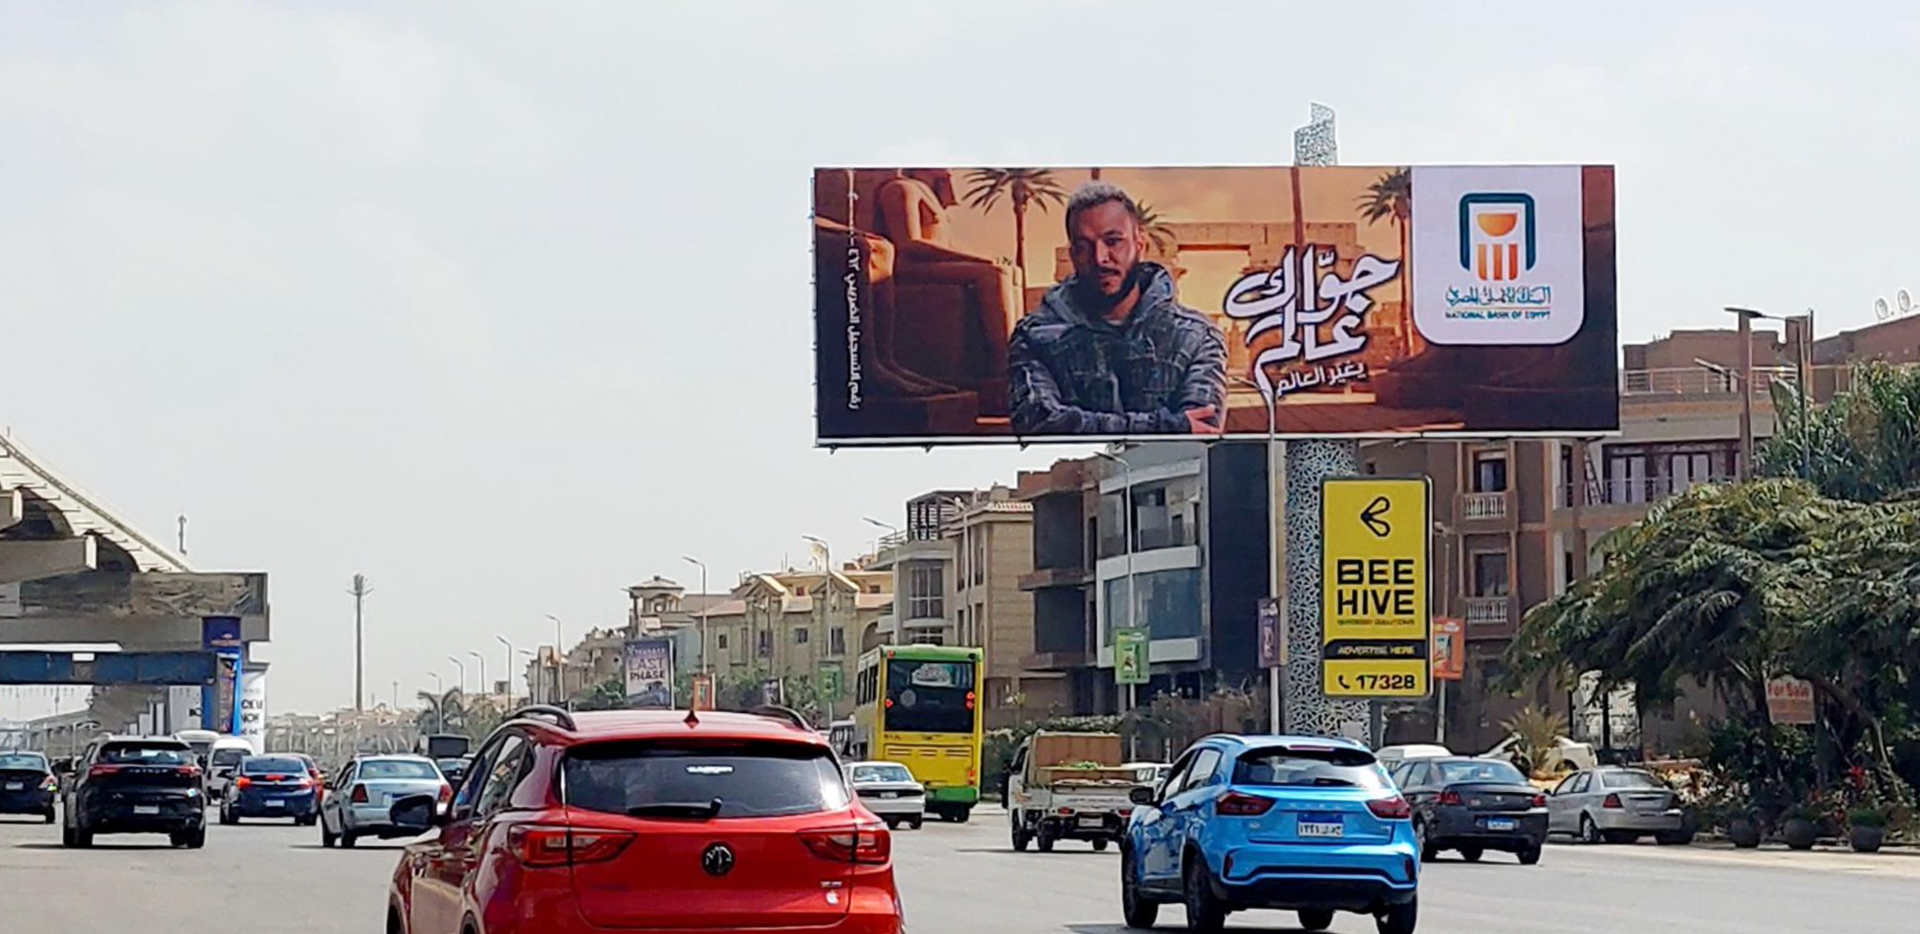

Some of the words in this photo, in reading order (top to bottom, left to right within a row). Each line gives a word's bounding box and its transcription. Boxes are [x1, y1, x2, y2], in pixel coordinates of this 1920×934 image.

[1277, 365, 1326, 397] العالم
[1337, 559, 1414, 585] BEE
[1337, 589, 1414, 615] HIVE
[1356, 675, 1415, 690] 17328
